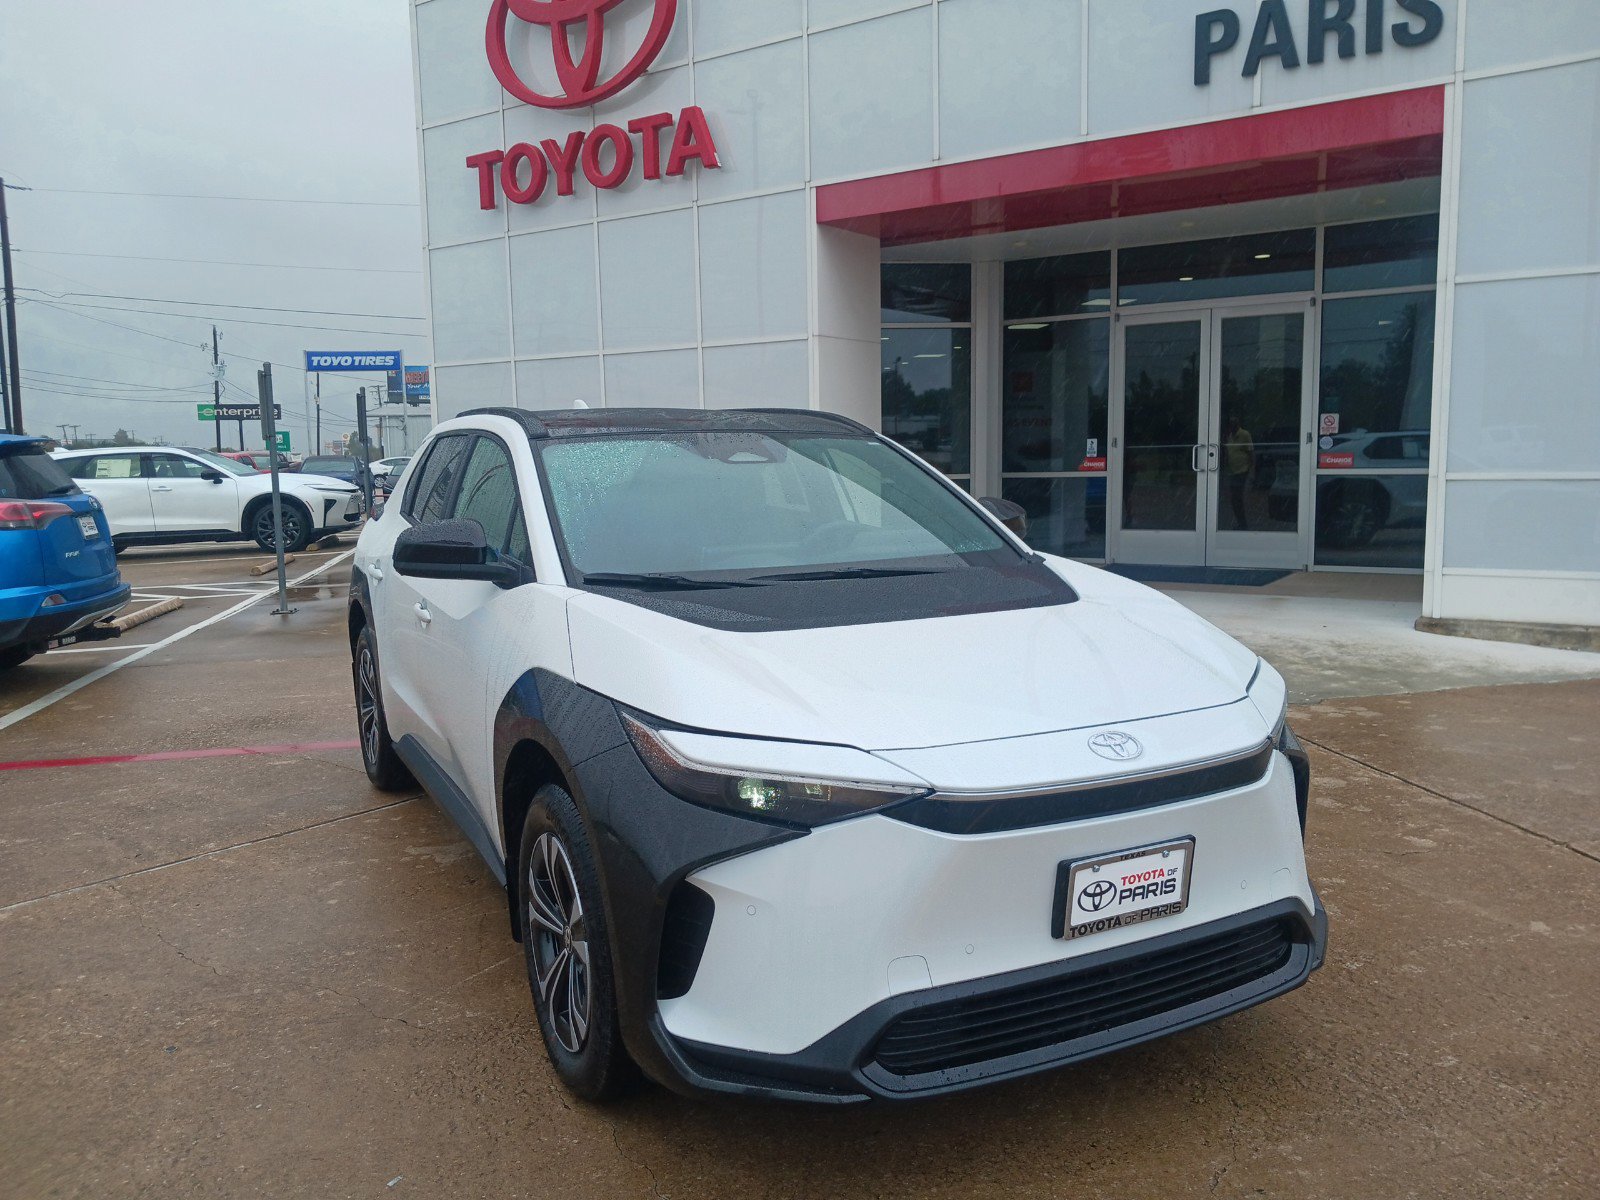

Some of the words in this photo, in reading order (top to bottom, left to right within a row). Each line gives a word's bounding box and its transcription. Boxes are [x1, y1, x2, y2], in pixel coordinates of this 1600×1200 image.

[1194, 0, 1444, 86] PARIS
[466, 105, 722, 210] TOYOTA
[311, 356, 353, 366] TOYO
[353, 355, 395, 366] TIRES
[1120, 850, 1146, 861] TEXAS
[1121, 868, 1165, 886] TOYOTA
[1167, 867, 1178, 876] OF
[1118, 877, 1177, 905] PARIS
[1069, 916, 1122, 938] TOYOTA
[1124, 914, 1138, 925] OF
[1140, 901, 1182, 921] PARIS
